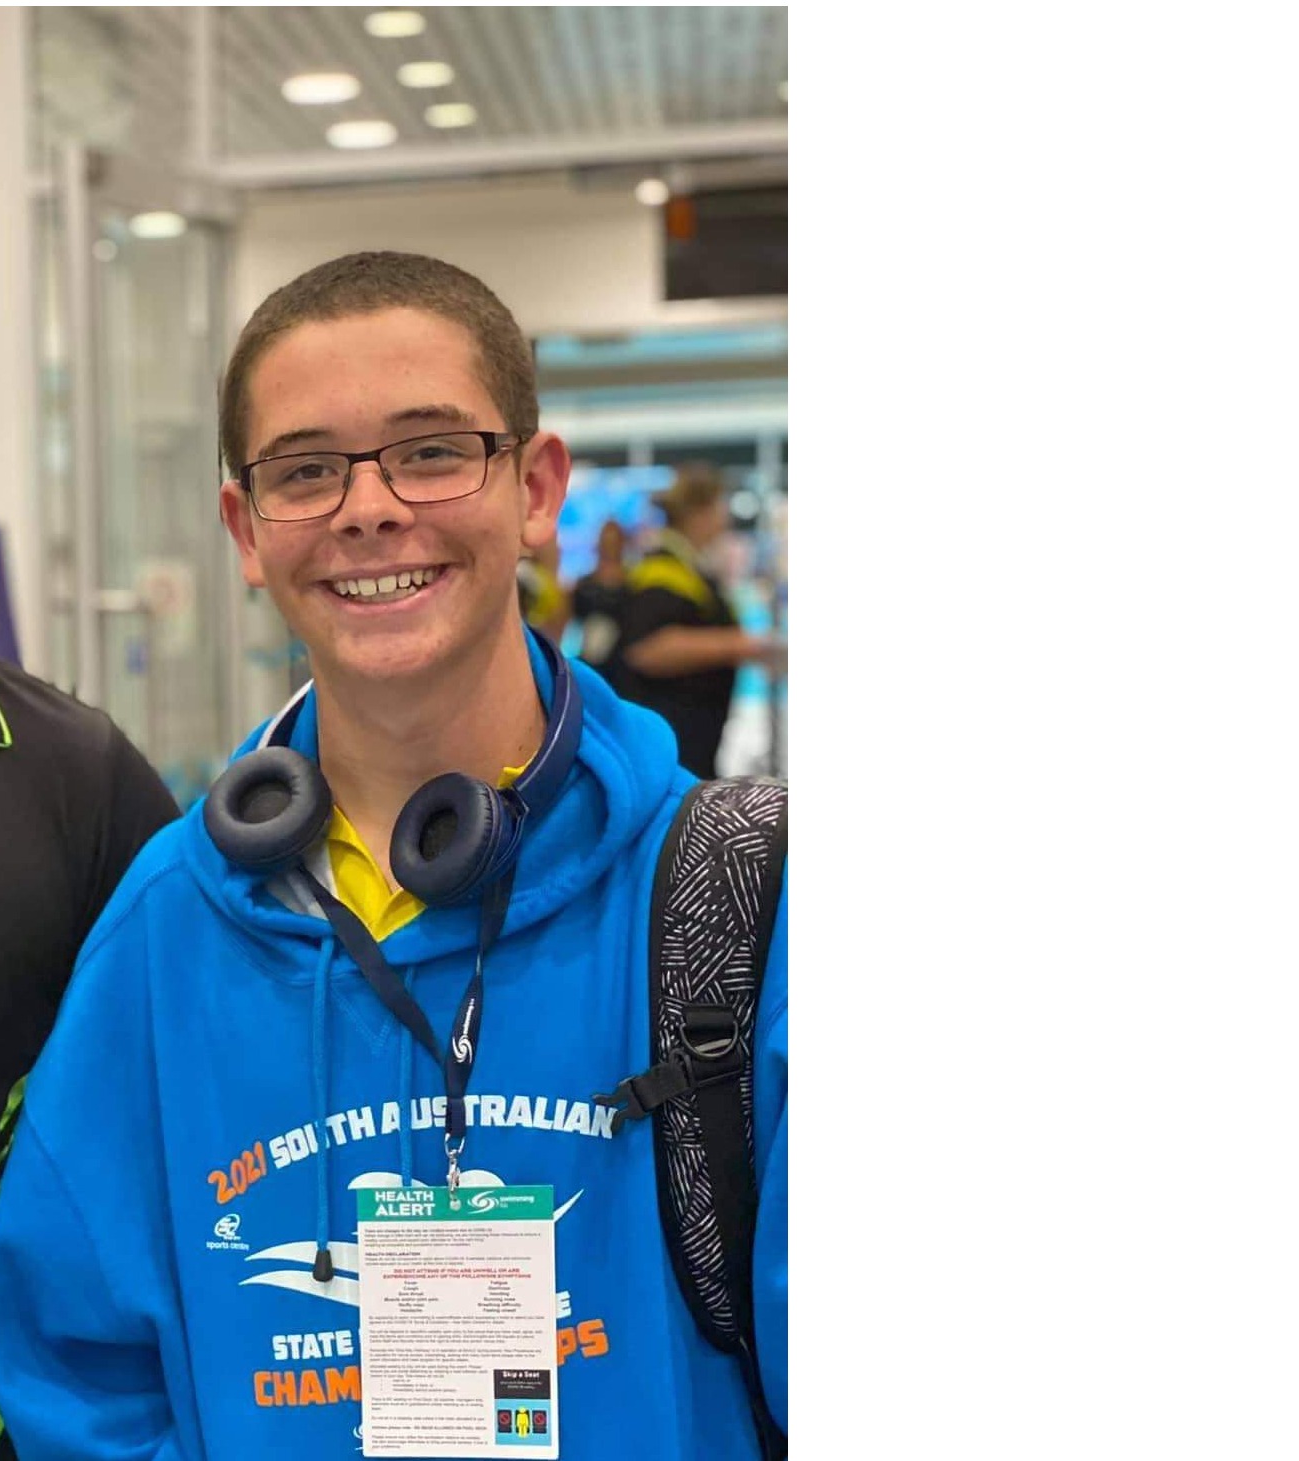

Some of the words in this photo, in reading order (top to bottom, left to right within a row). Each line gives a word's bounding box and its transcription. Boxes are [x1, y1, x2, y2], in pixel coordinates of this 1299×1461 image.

[207, 1141, 267, 1205] 2021
[268, 1106, 376, 1169] SOUTH
[381, 1095, 617, 1139] AUSTRALIAN
[375, 1190, 434, 1202] HEALTH
[375, 1203, 436, 1216] ALERT
[272, 1330, 354, 1361] STATE
